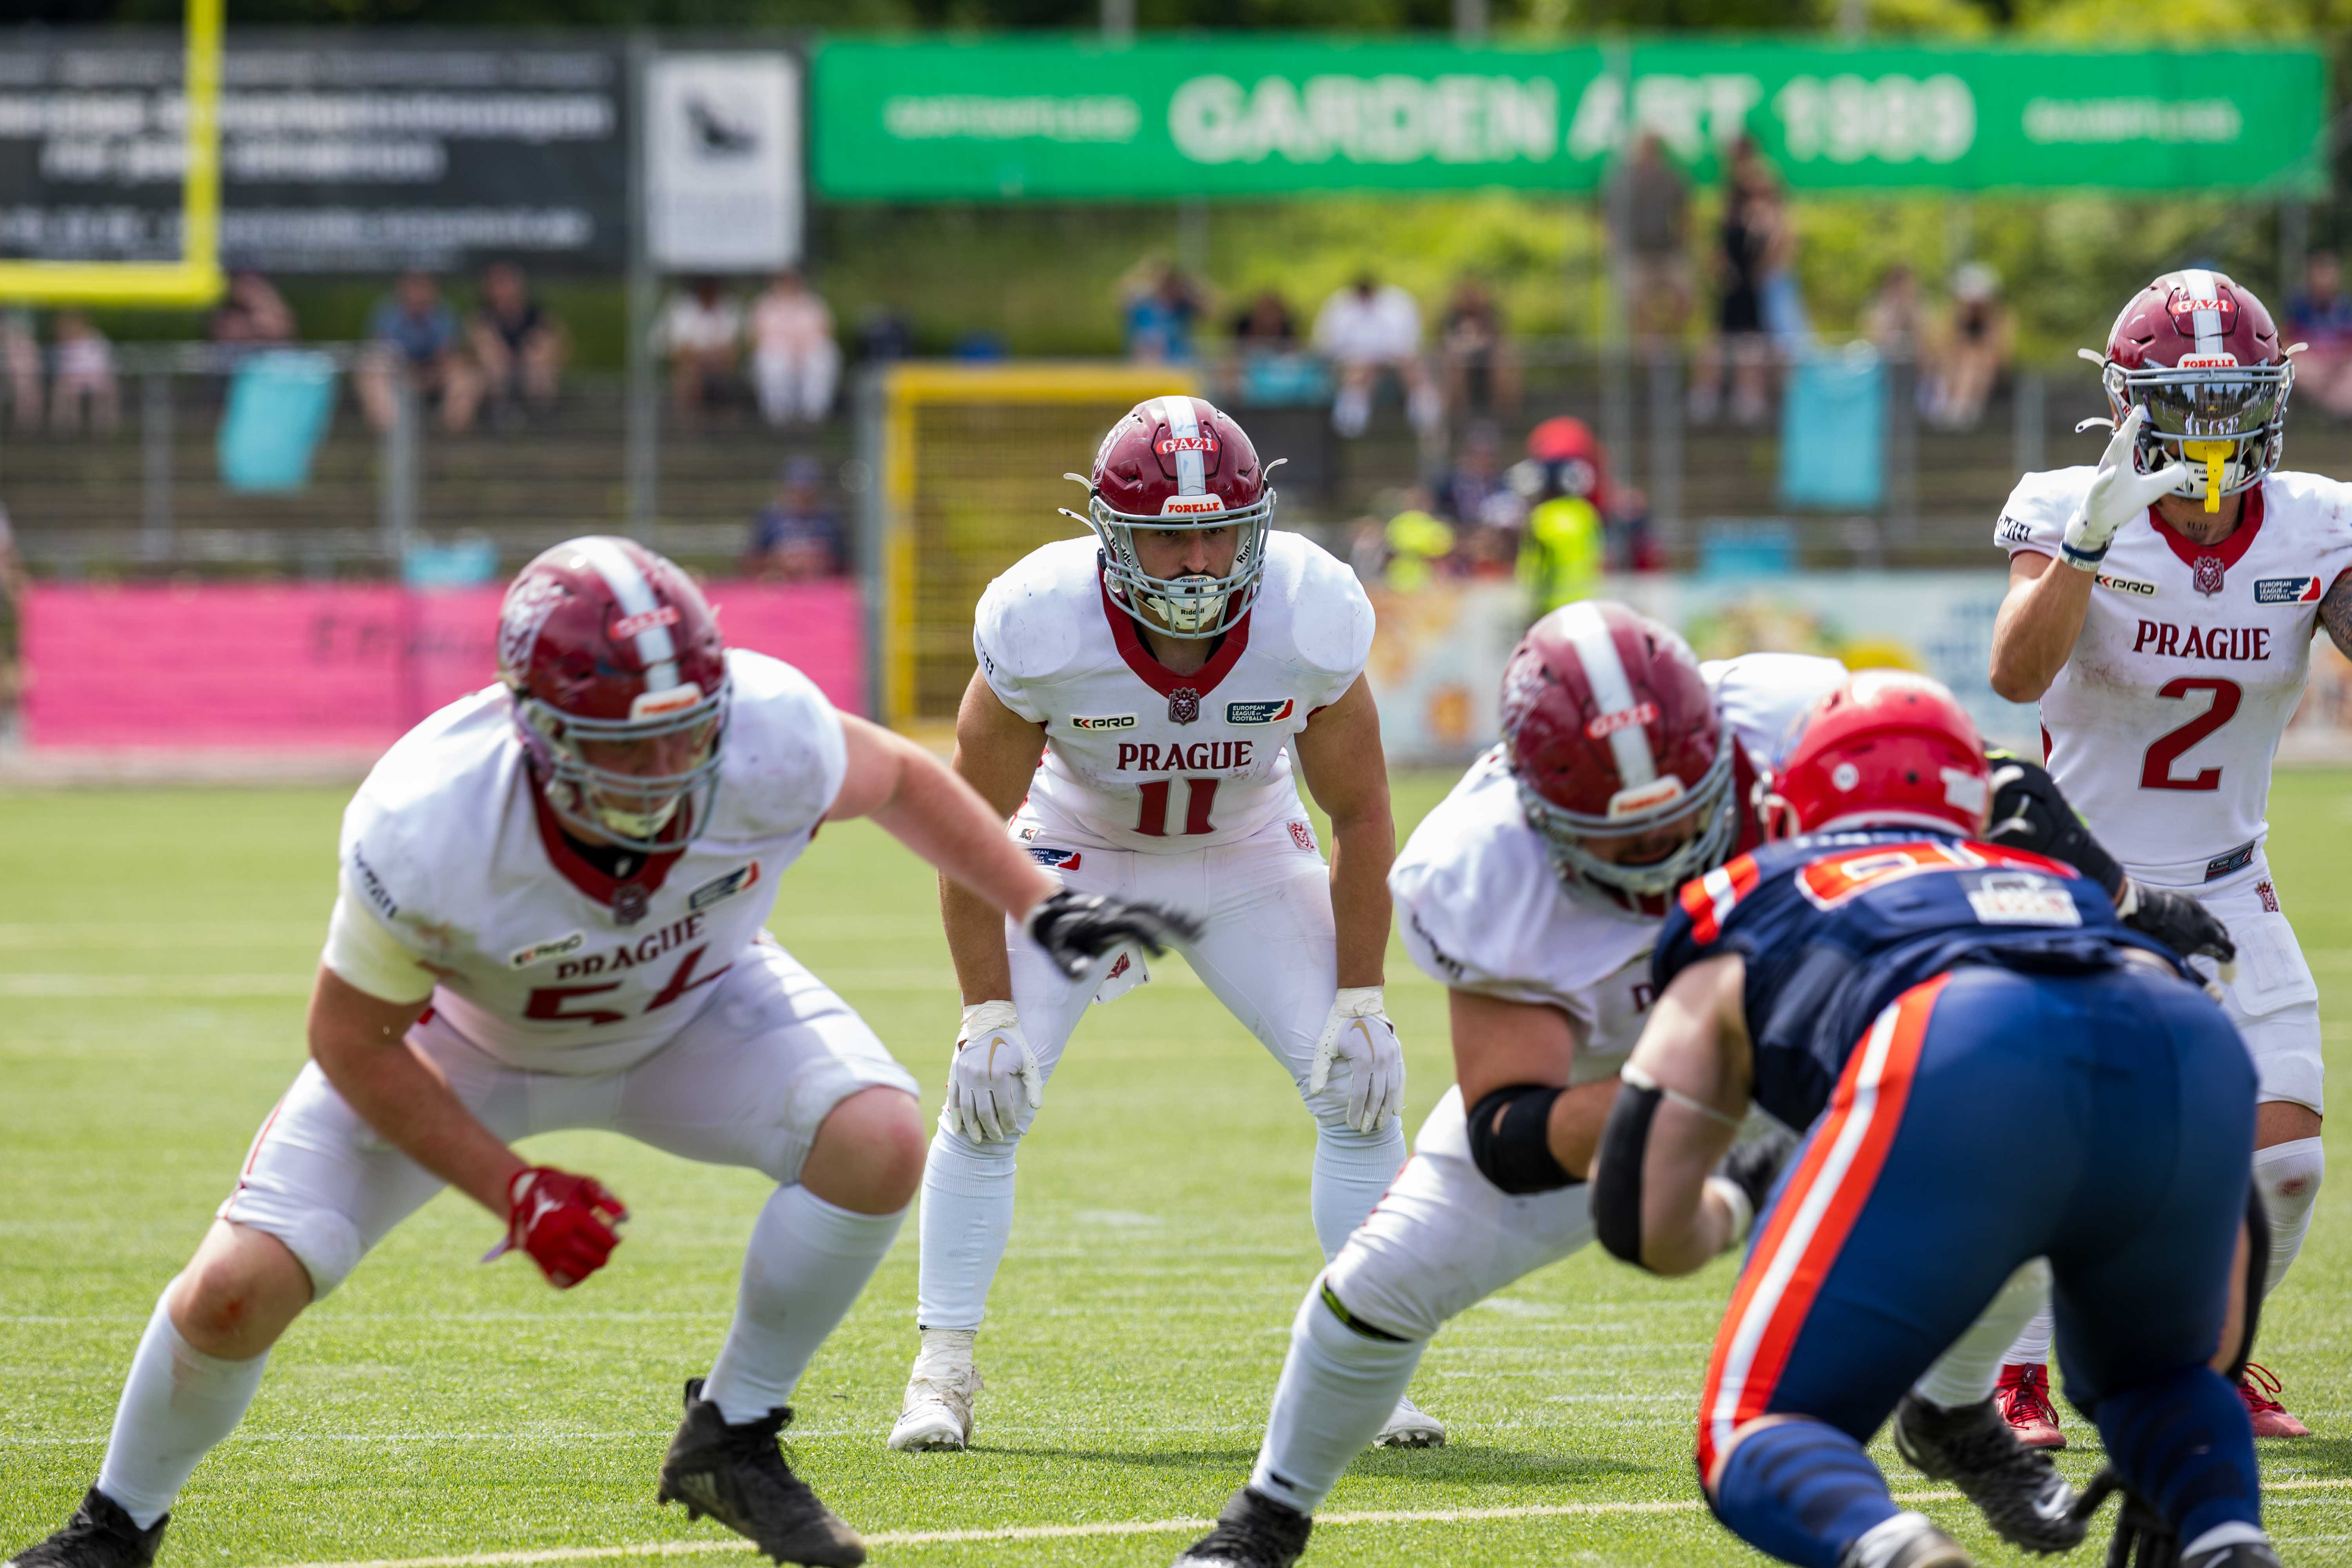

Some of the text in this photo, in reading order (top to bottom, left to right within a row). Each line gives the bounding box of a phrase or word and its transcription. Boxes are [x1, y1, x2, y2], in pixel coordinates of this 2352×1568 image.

[1170, 75, 1557, 163] GARDEN
[1569, 74, 1762, 163] ART
[1773, 75, 1974, 163] 1989
[2178, 300, 2229, 312] GAZI
[2183, 359, 2234, 368] FORELLE
[1162, 437, 1213, 454] GAZI
[1168, 502, 1220, 513] FORELLE
[2259, 580, 2292, 588] EUROPEAN
[2260, 592, 2291, 602] FOOTBALL
[2132, 619, 2271, 661] PRAGUE
[2138, 676, 2244, 792] 2
[1116, 740, 1253, 771] PRAGUE
[1130, 777, 1221, 836] 11
[556, 912, 705, 979] PRAGUE
